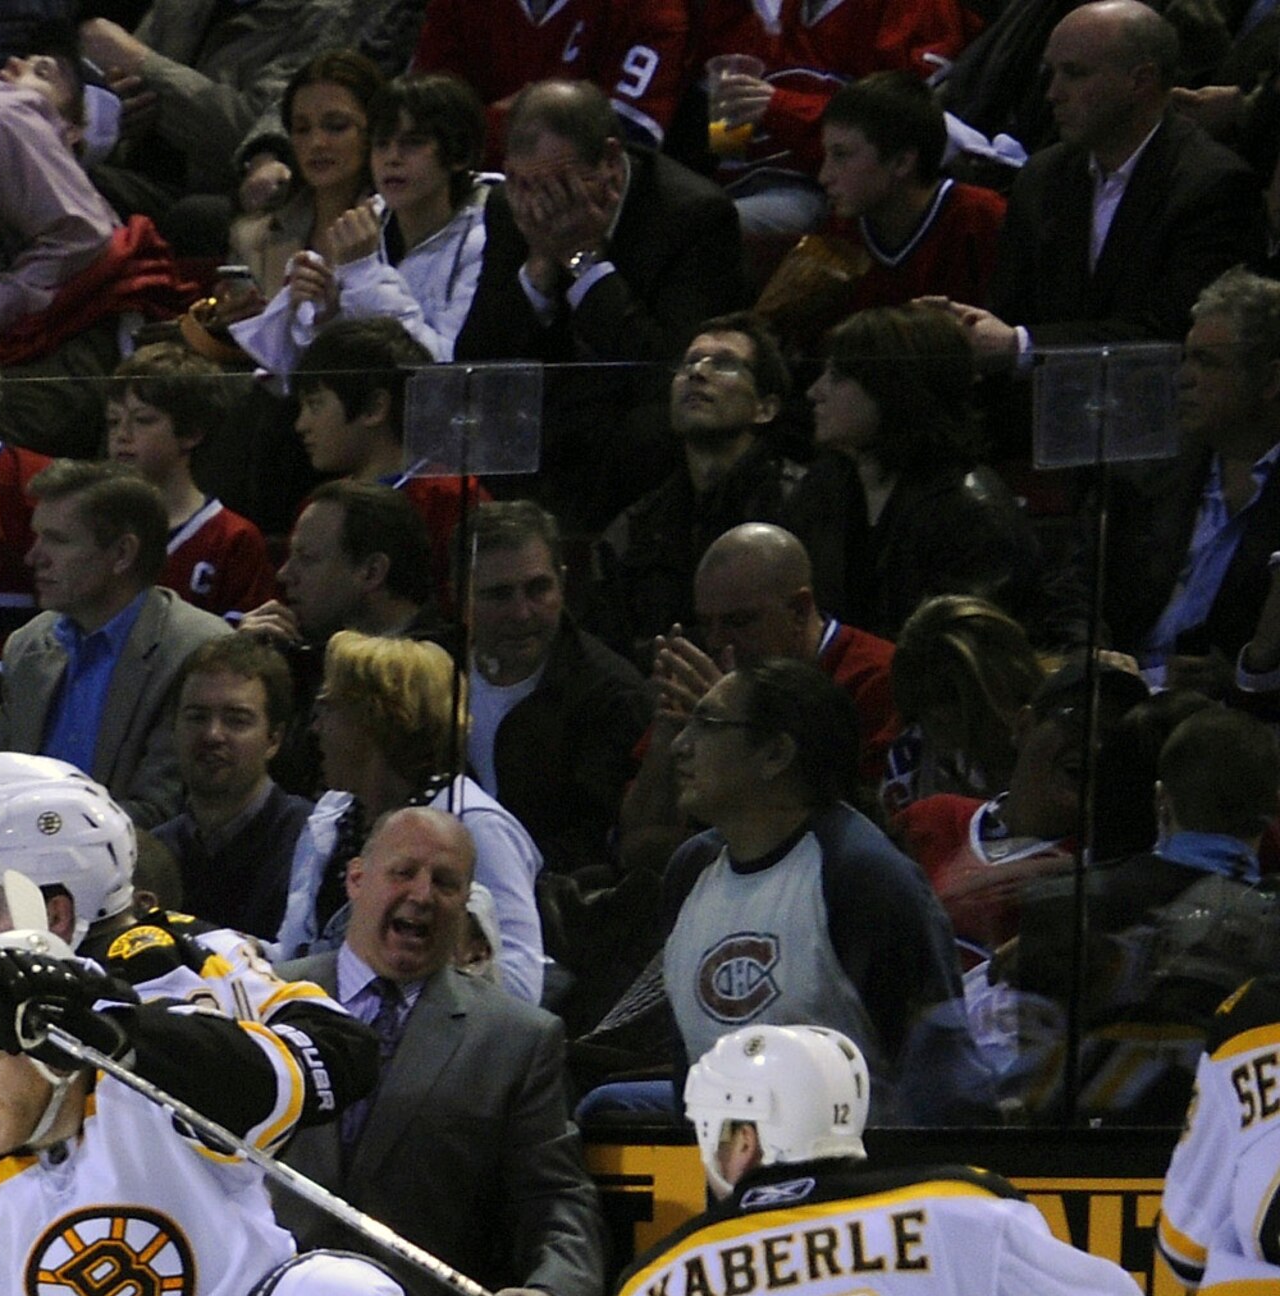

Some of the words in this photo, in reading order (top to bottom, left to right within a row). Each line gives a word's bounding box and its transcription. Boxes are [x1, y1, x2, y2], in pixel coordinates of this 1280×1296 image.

[616, 44, 660, 98] 9
[192, 561, 215, 594] C
[1231, 1052, 1280, 1130] SE
[832, 1103, 852, 1125] 12
